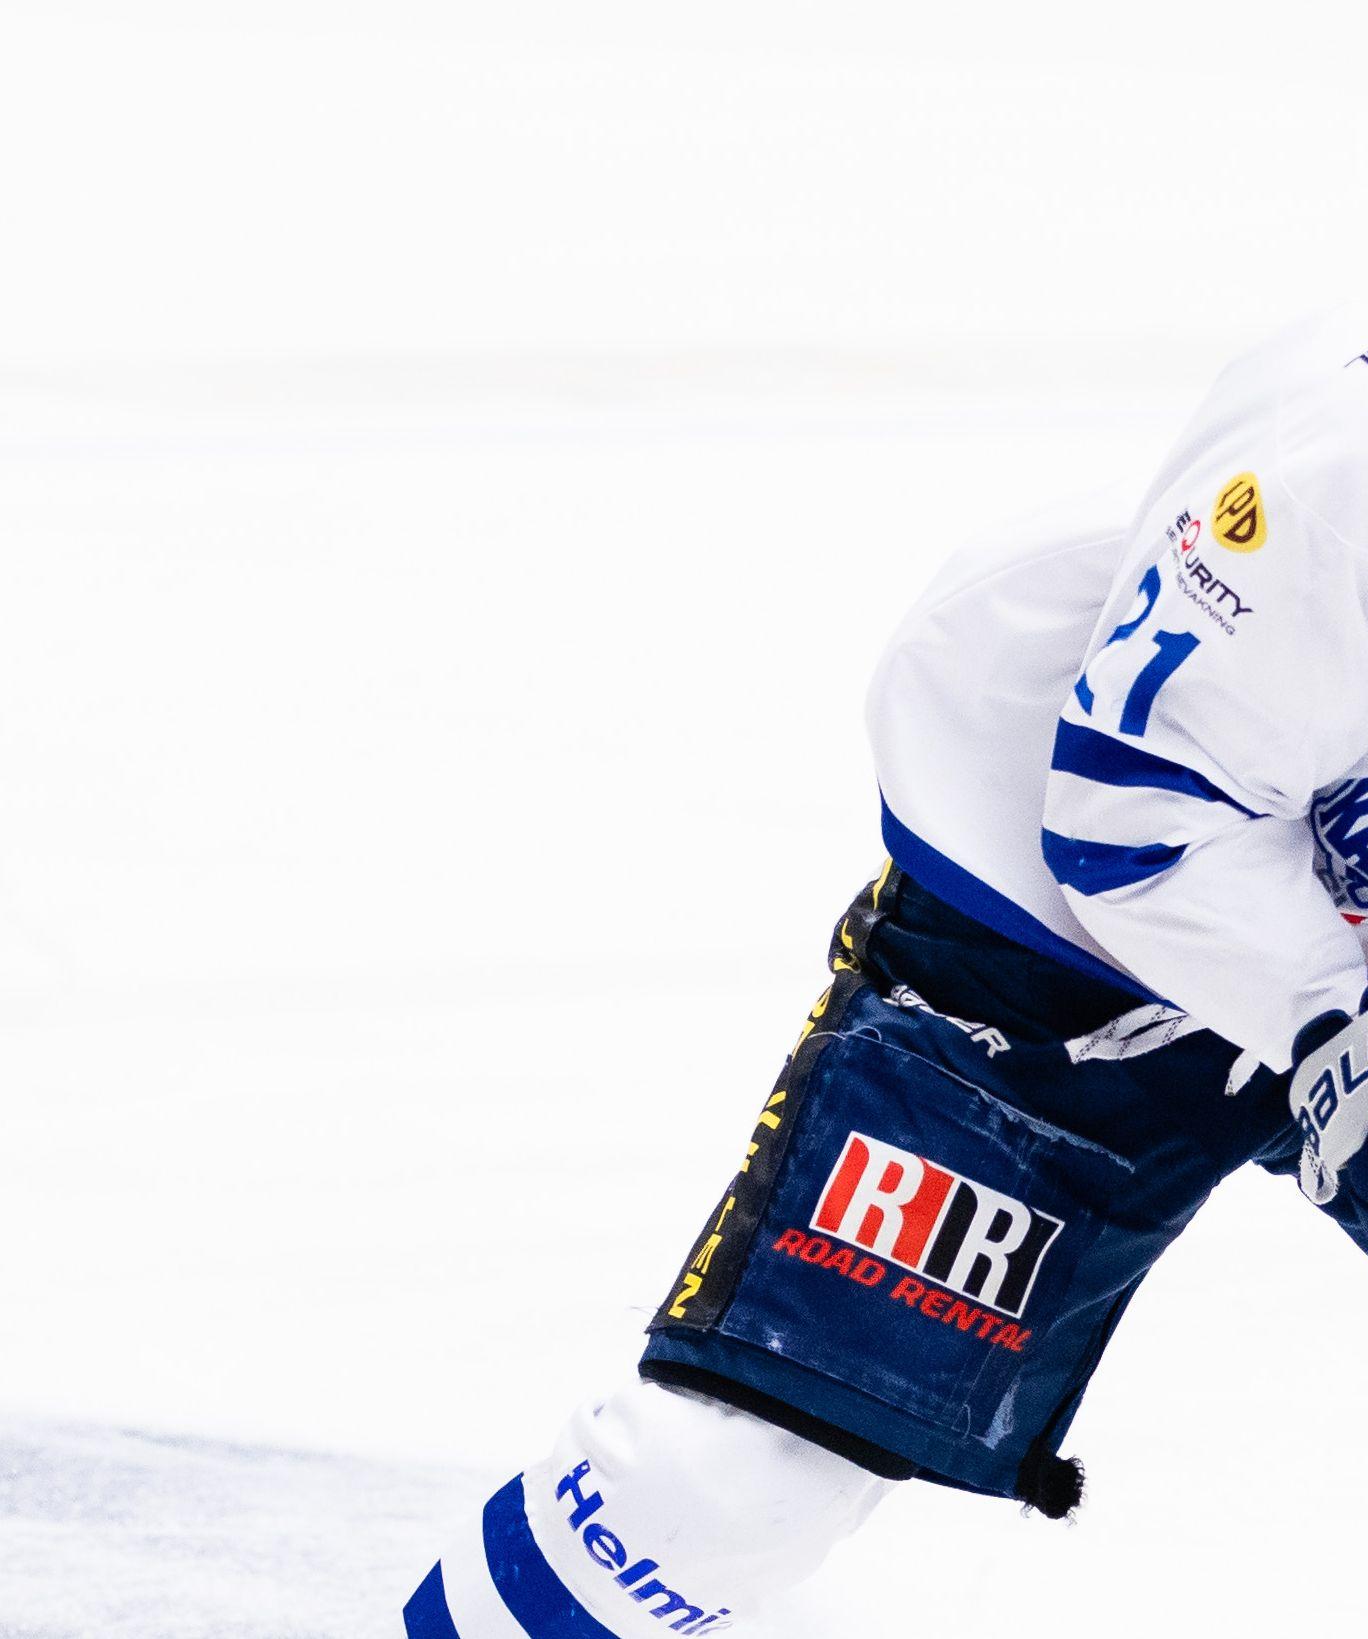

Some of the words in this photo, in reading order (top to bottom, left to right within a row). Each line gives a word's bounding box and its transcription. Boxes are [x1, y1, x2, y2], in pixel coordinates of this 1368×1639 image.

[1074, 563, 1202, 738] 21
[771, 1227, 887, 1288] ROAD
[890, 1275, 1033, 1353] RENTAL
